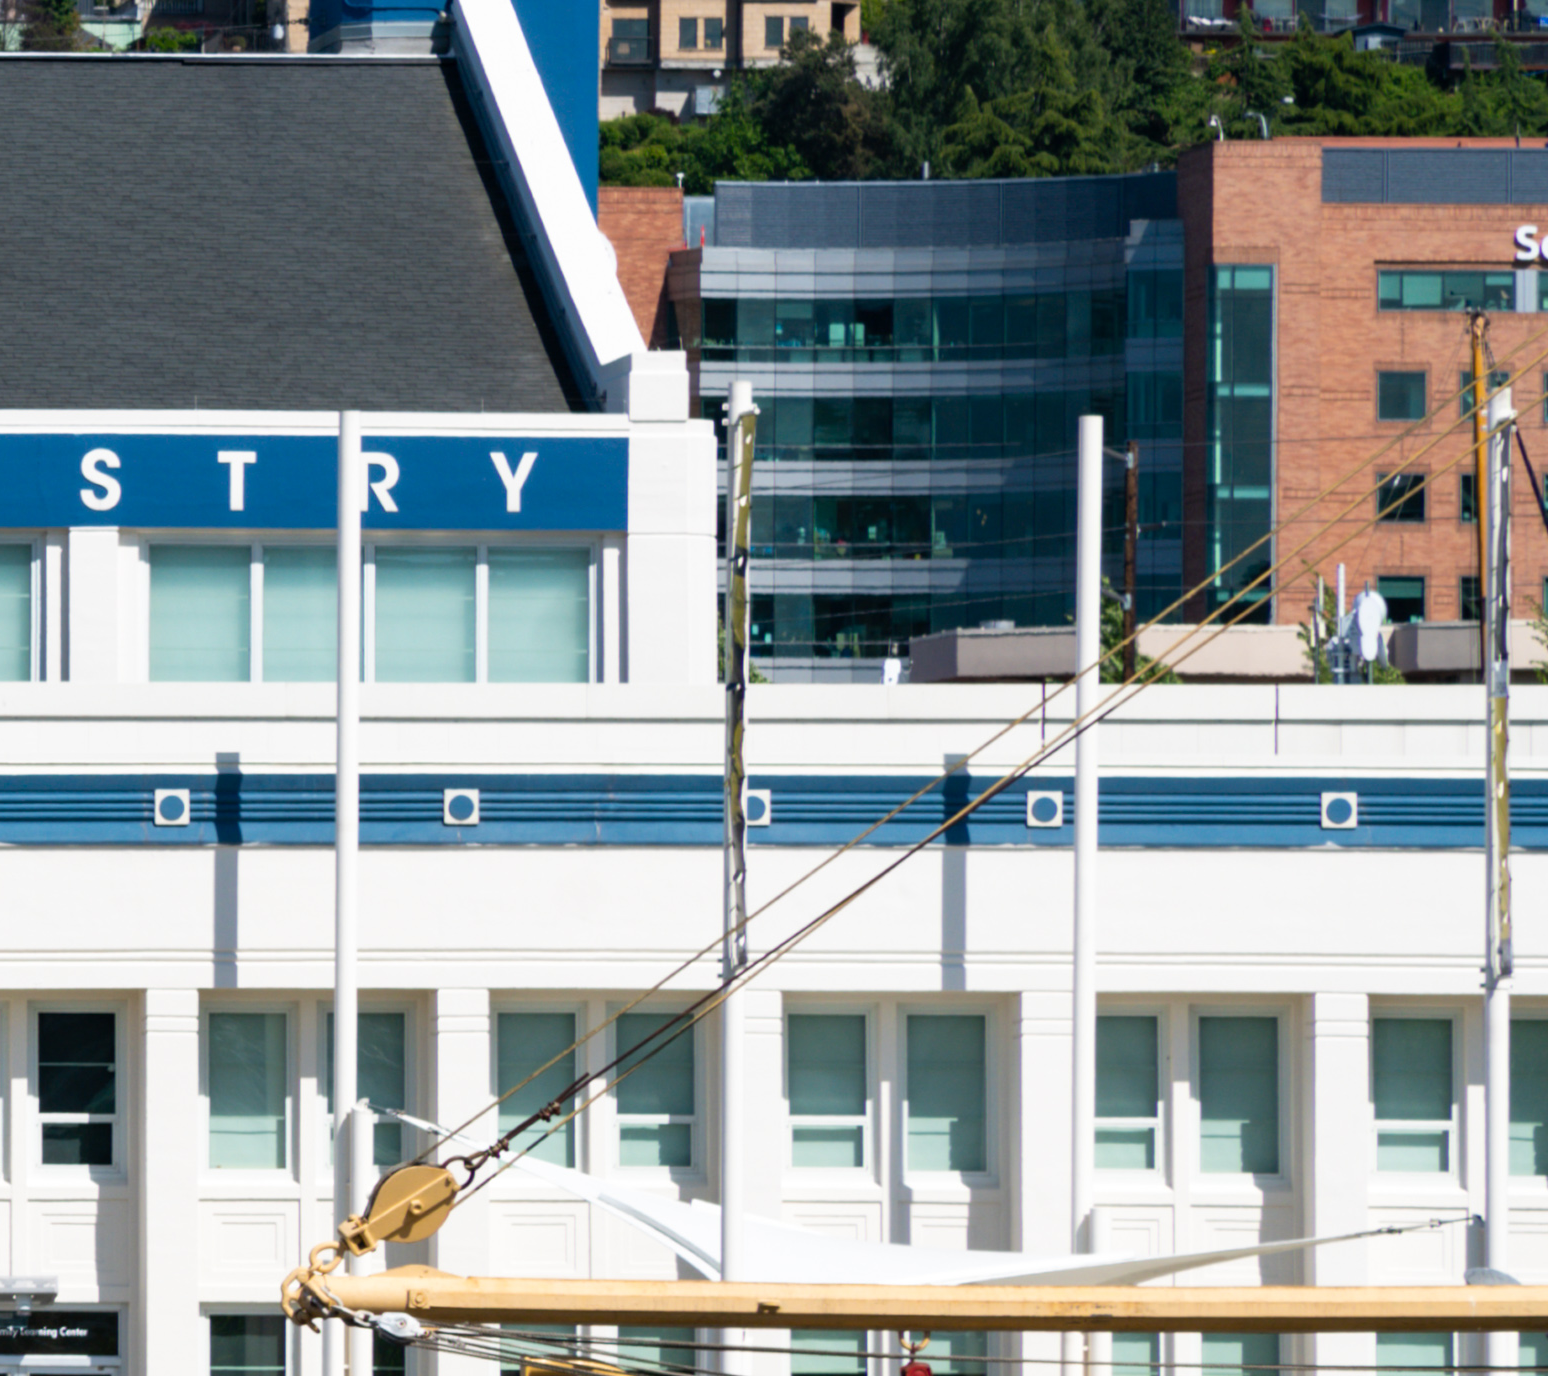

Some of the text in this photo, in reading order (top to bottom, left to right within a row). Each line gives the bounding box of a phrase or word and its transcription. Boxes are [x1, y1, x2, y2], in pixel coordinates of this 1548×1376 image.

[1515, 224, 1548, 262] S
[20, 1326, 58, 1339] Learning
[59, 1326, 88, 1337] Center
